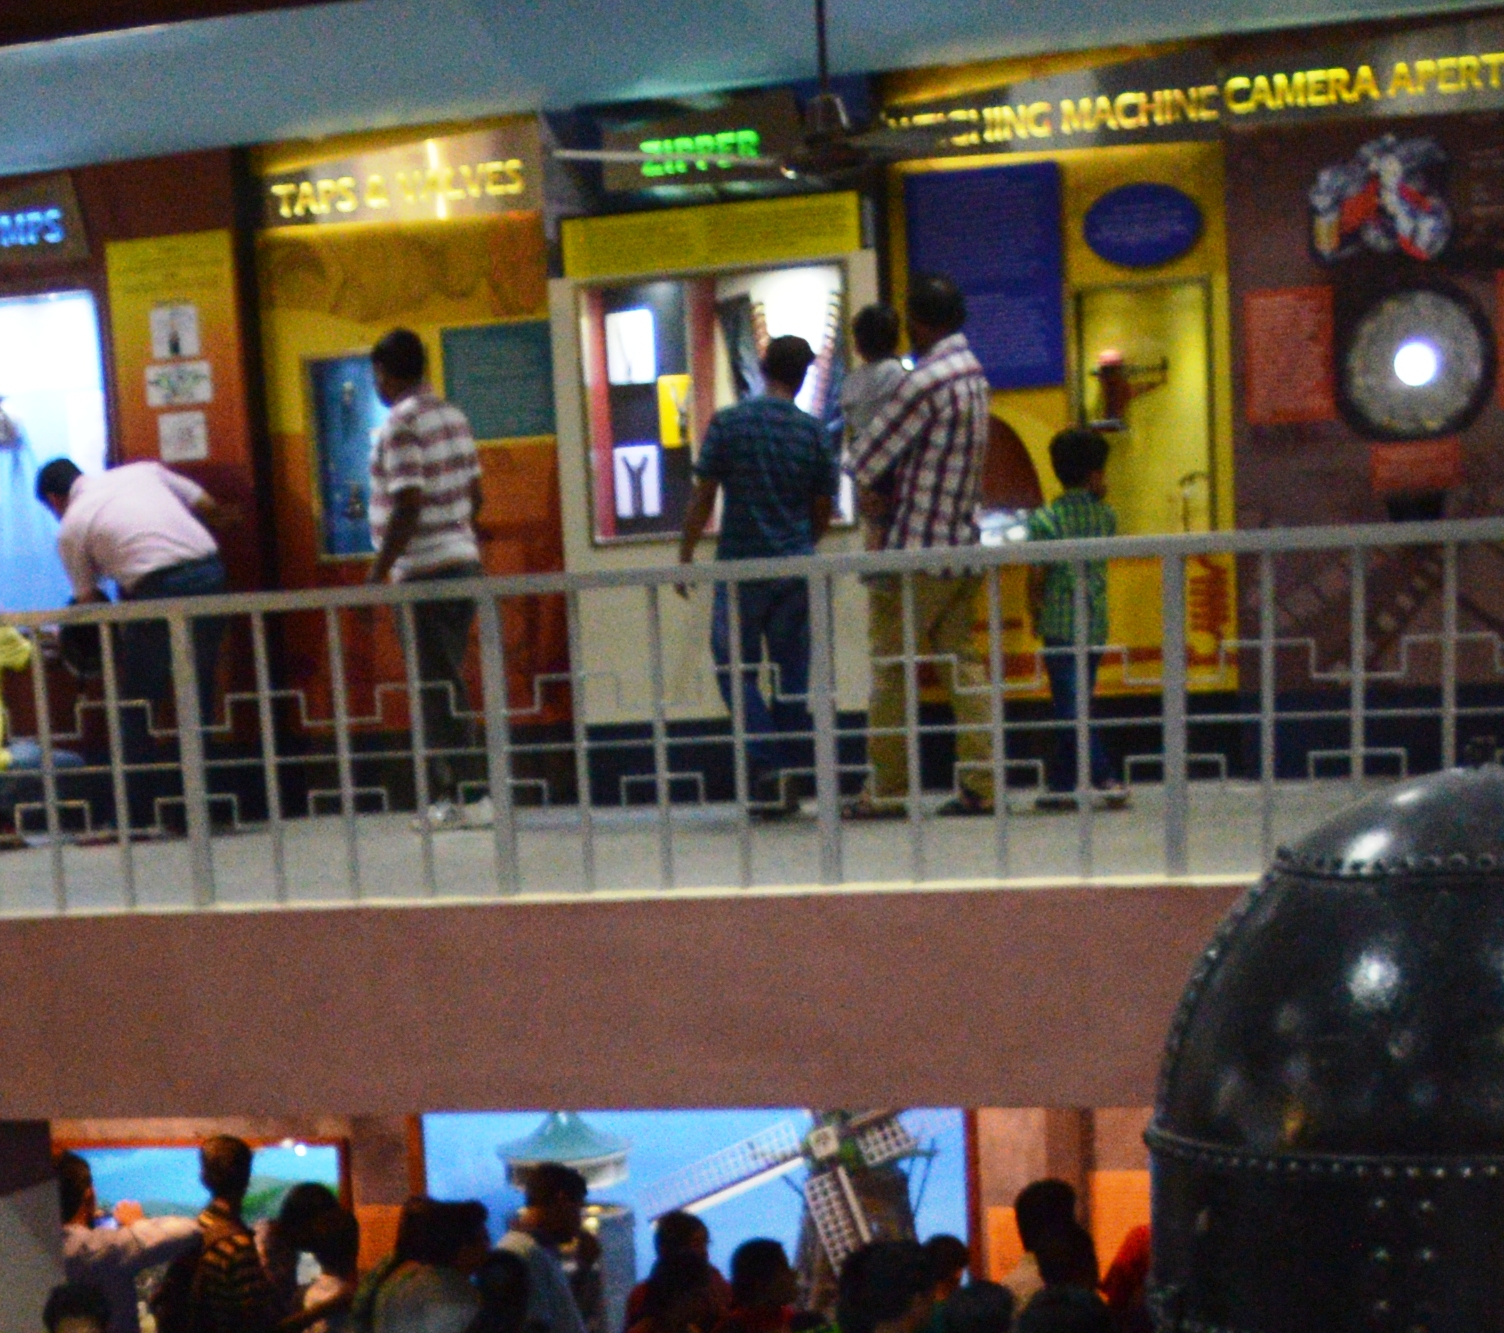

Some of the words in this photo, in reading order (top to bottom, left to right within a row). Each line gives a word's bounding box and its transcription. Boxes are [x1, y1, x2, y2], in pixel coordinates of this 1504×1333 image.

[880, 101, 1051, 147] GHING
[1060, 85, 1219, 134] MACHINE
[1224, 65, 1379, 116] CAMERA
[639, 128, 760, 177] ZIPPER
[270, 177, 356, 218] TAPS
[363, 174, 389, 209] &
[396, 158, 525, 204] VALVES
